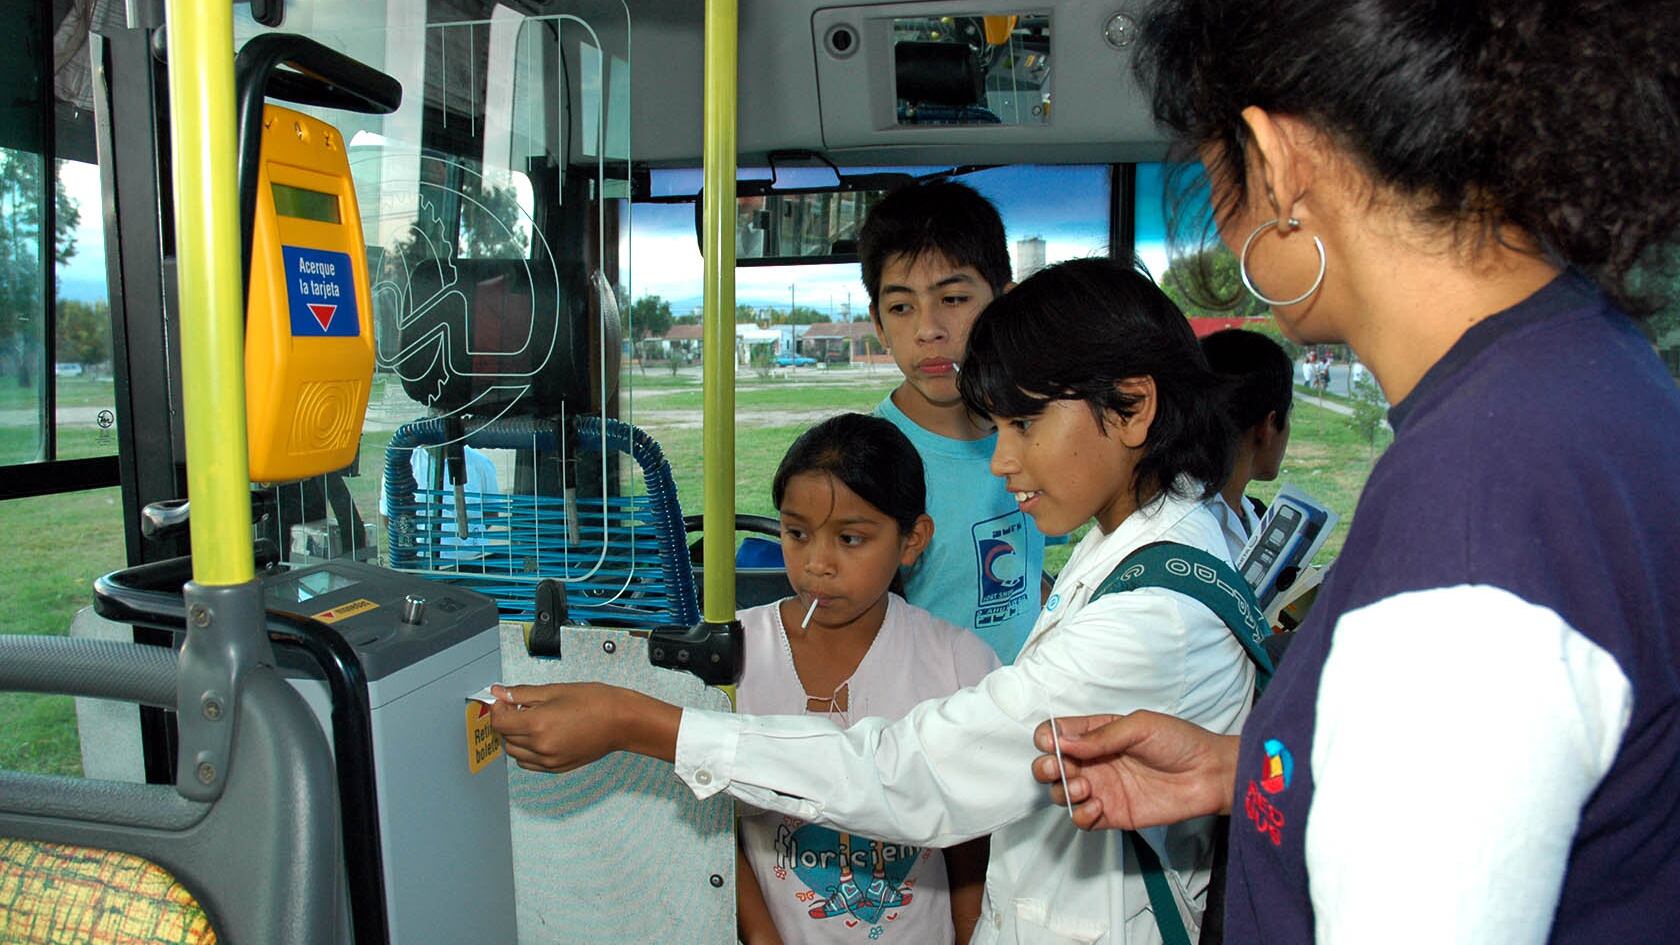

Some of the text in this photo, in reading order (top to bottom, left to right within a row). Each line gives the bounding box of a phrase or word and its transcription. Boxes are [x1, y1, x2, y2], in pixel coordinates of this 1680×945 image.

[299, 257, 336, 278] Acerque
[299, 278, 340, 299] la tarjeta
[774, 824, 922, 869] floricien
